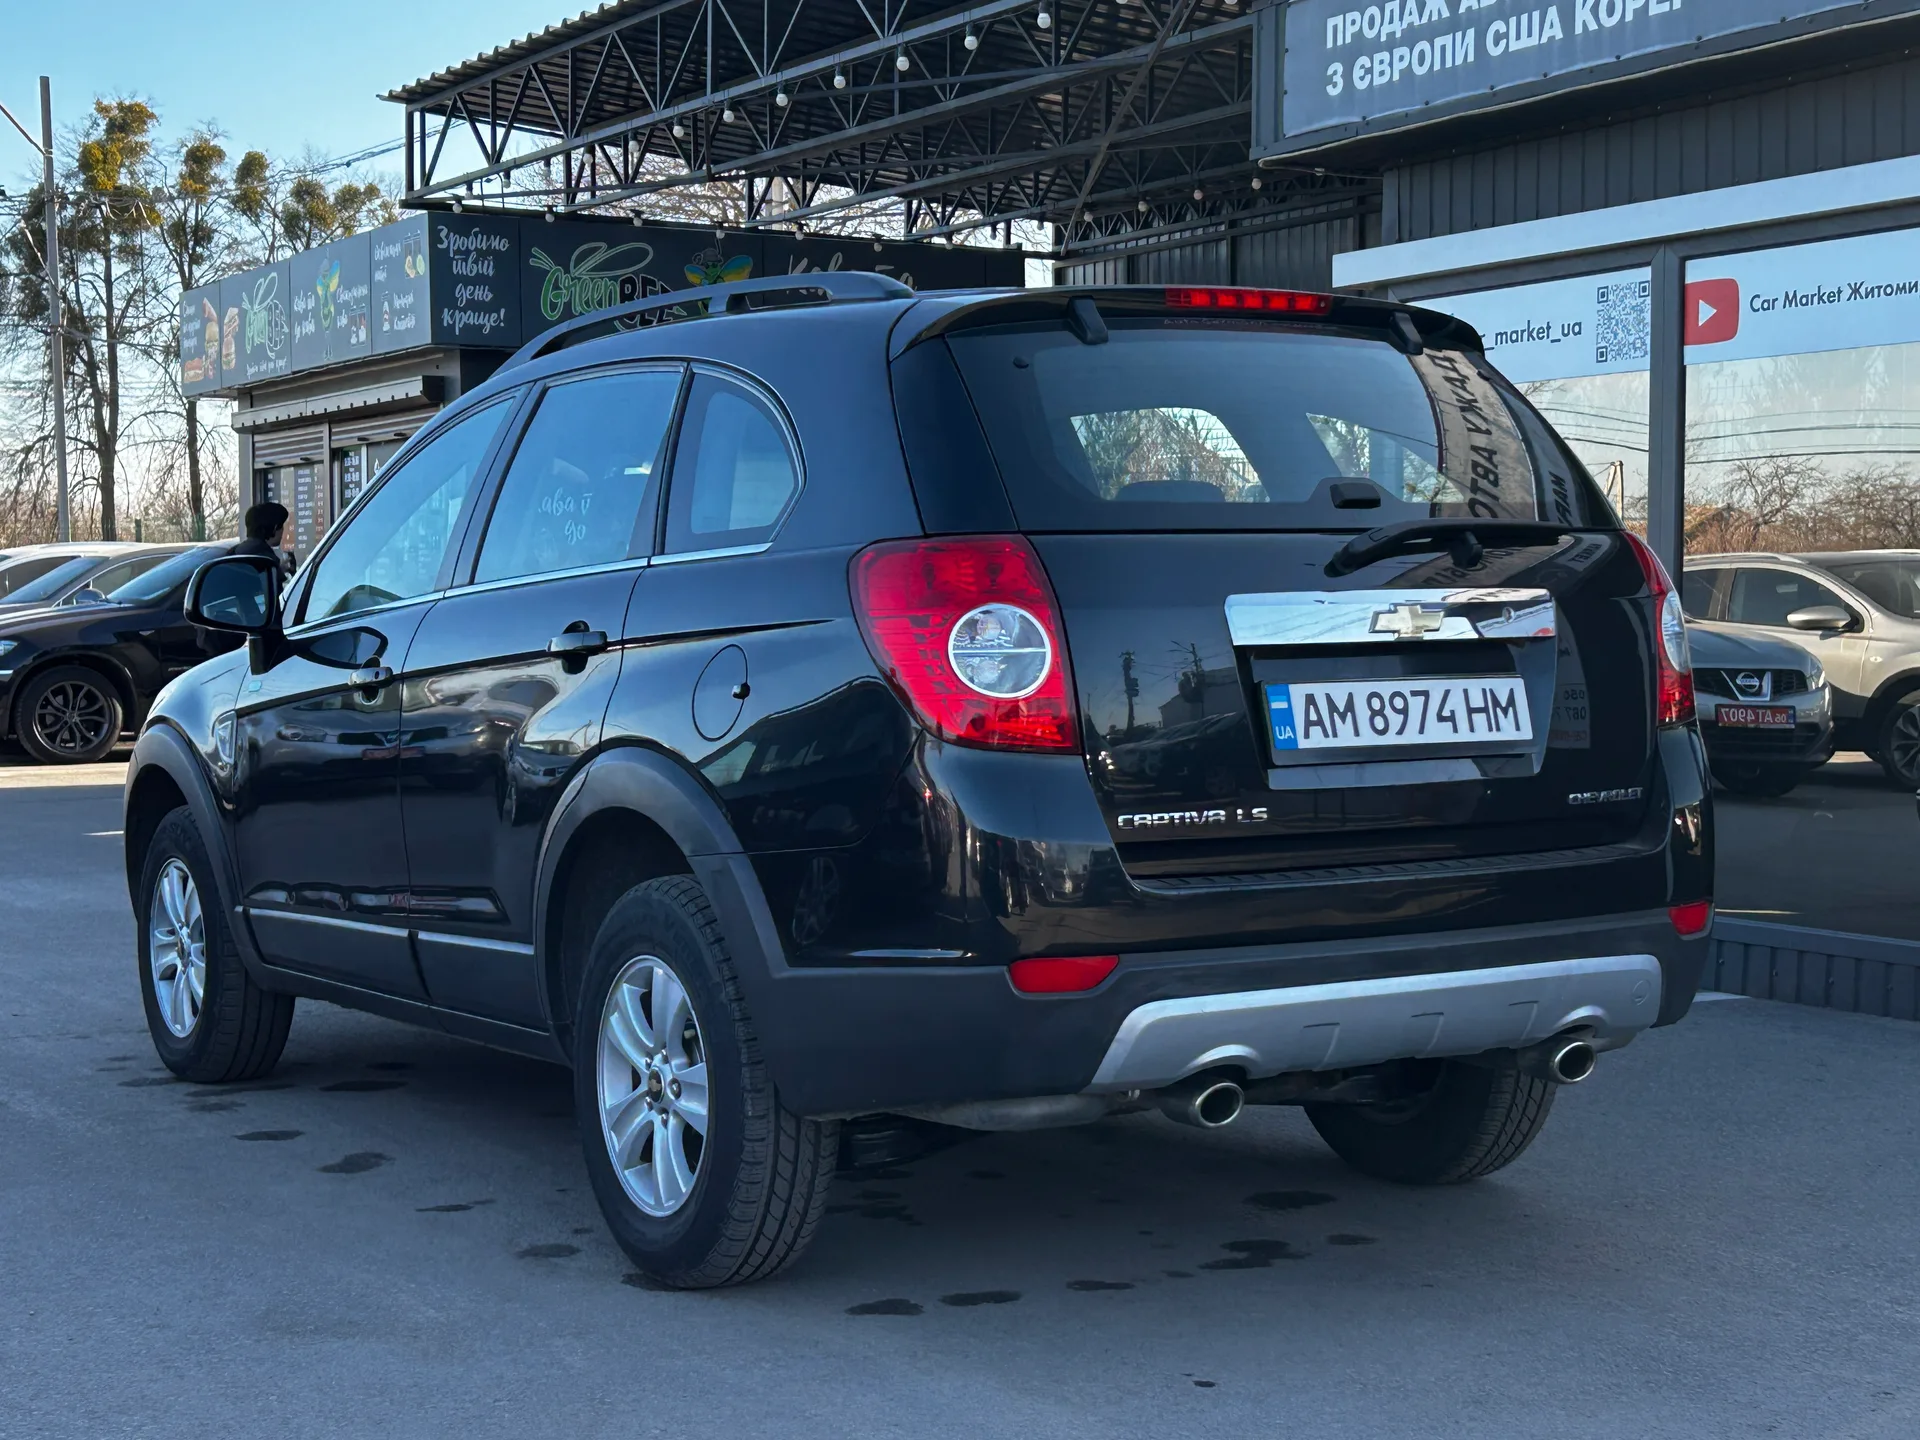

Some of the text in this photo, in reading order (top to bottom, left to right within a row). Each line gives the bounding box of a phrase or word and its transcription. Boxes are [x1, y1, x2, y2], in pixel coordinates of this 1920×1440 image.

[1326, 0, 1450, 48] ПРОДАЖ
[1326, 62, 1344, 96] З
[1352, 27, 1475, 90] ЄВРОПИ
[1485, 5, 1563, 57] США
[437, 225, 510, 258] Зробимо
[452, 252, 495, 277] твій
[455, 283, 493, 307] день
[1750, 280, 1920, 313] Car Market Житоми
[441, 308, 505, 334] краще!
[1481, 319, 1582, 351] _market_ua
[1275, 726, 1294, 739] UA
[1117, 807, 1268, 829] CAPTIVA LS
